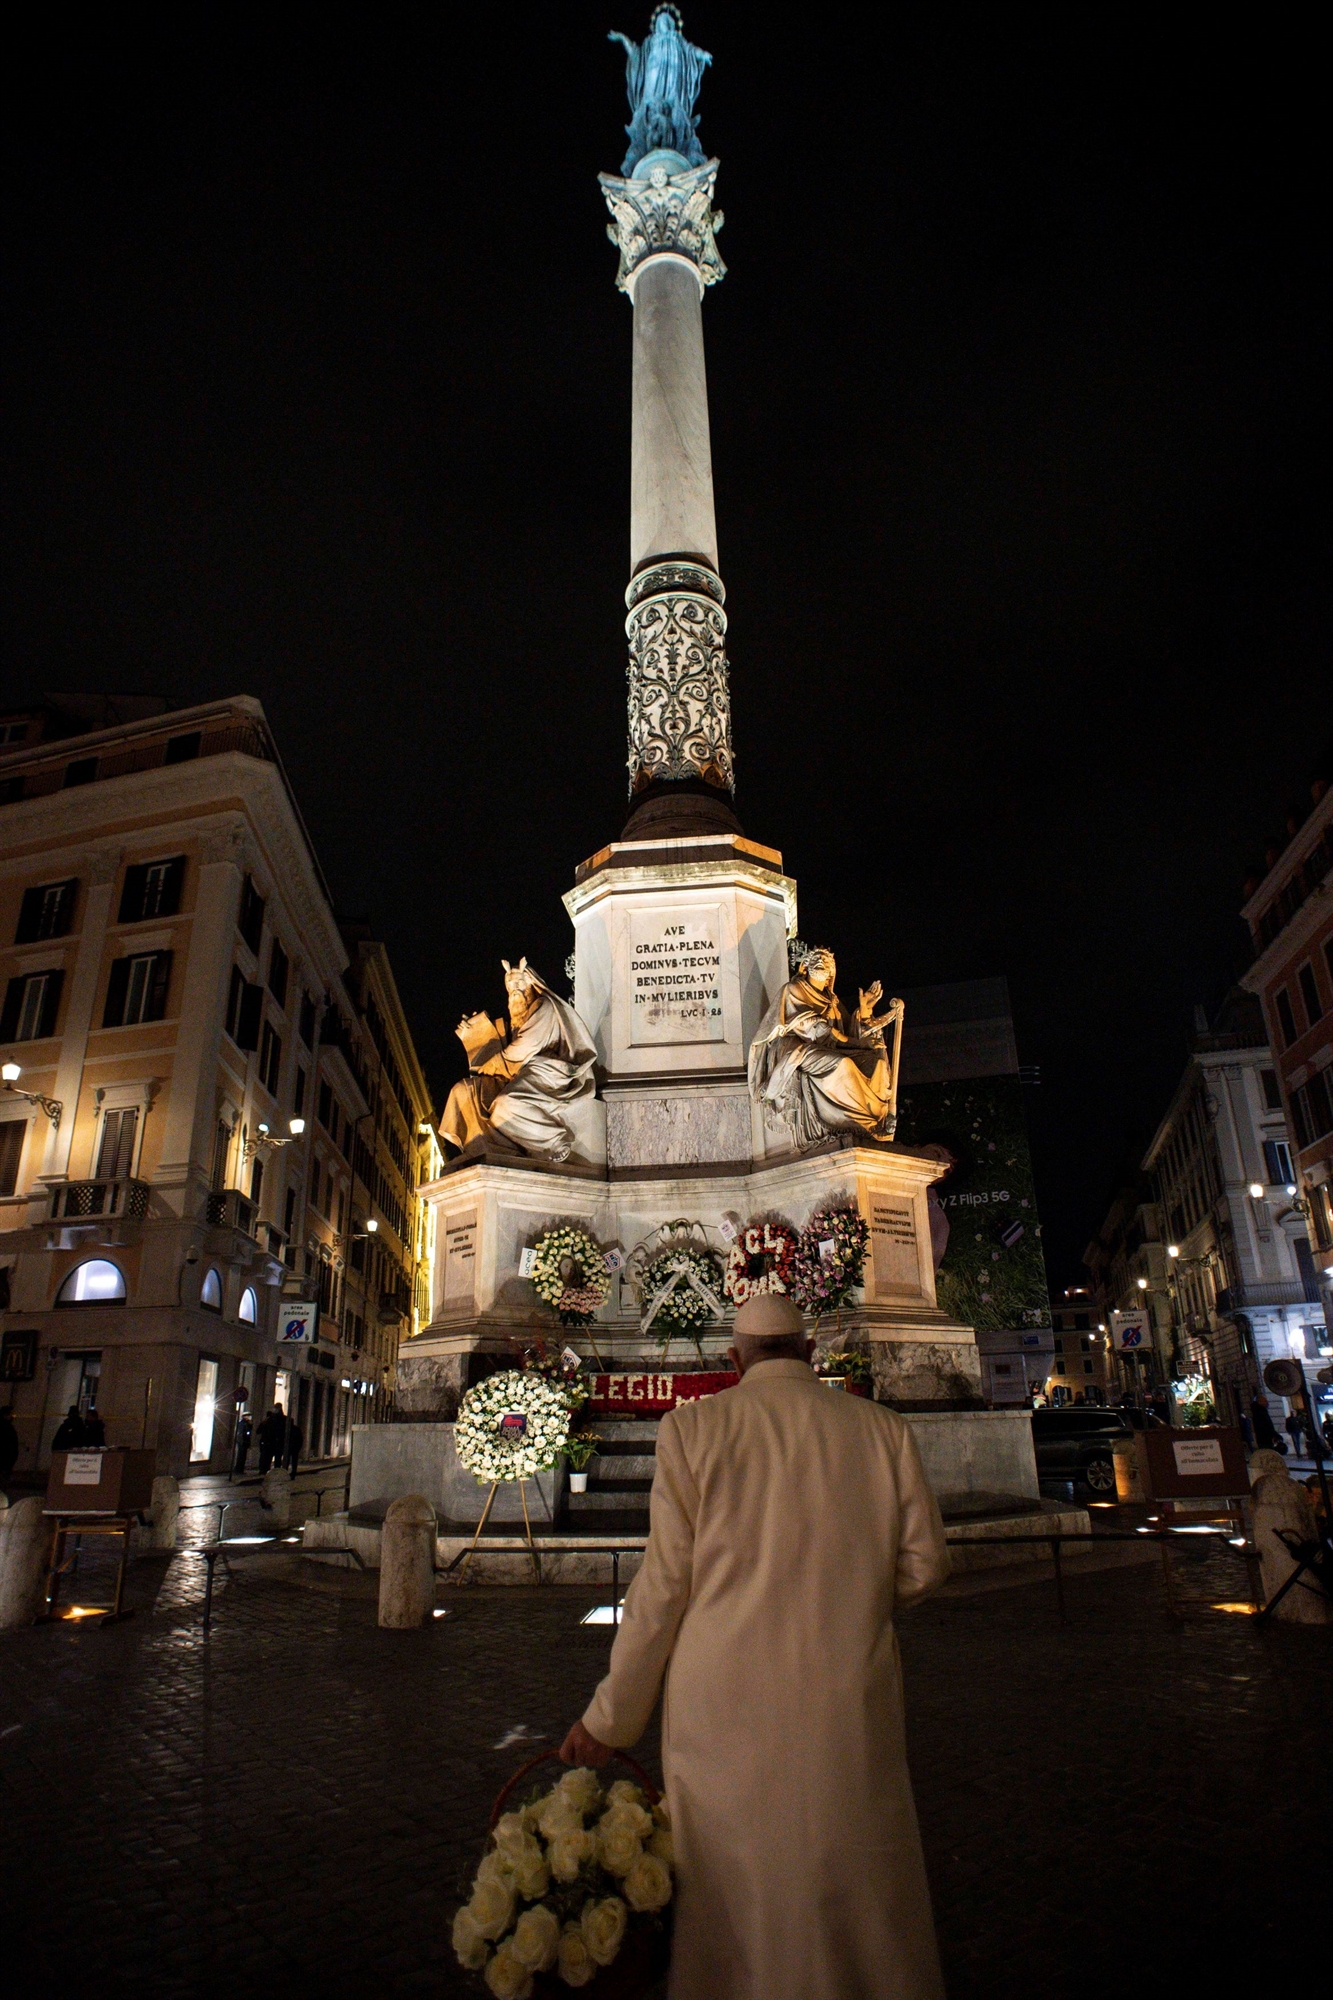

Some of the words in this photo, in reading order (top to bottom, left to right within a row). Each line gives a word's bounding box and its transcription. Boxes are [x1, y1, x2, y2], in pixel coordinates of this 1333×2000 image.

[664, 926, 685, 936] AVE
[949, 1195, 957, 1206] Z
[960, 1192, 988, 1208] Flip3
[992, 1190, 1010, 1202] 5G
[590, 1375, 673, 1400] LEGIO
